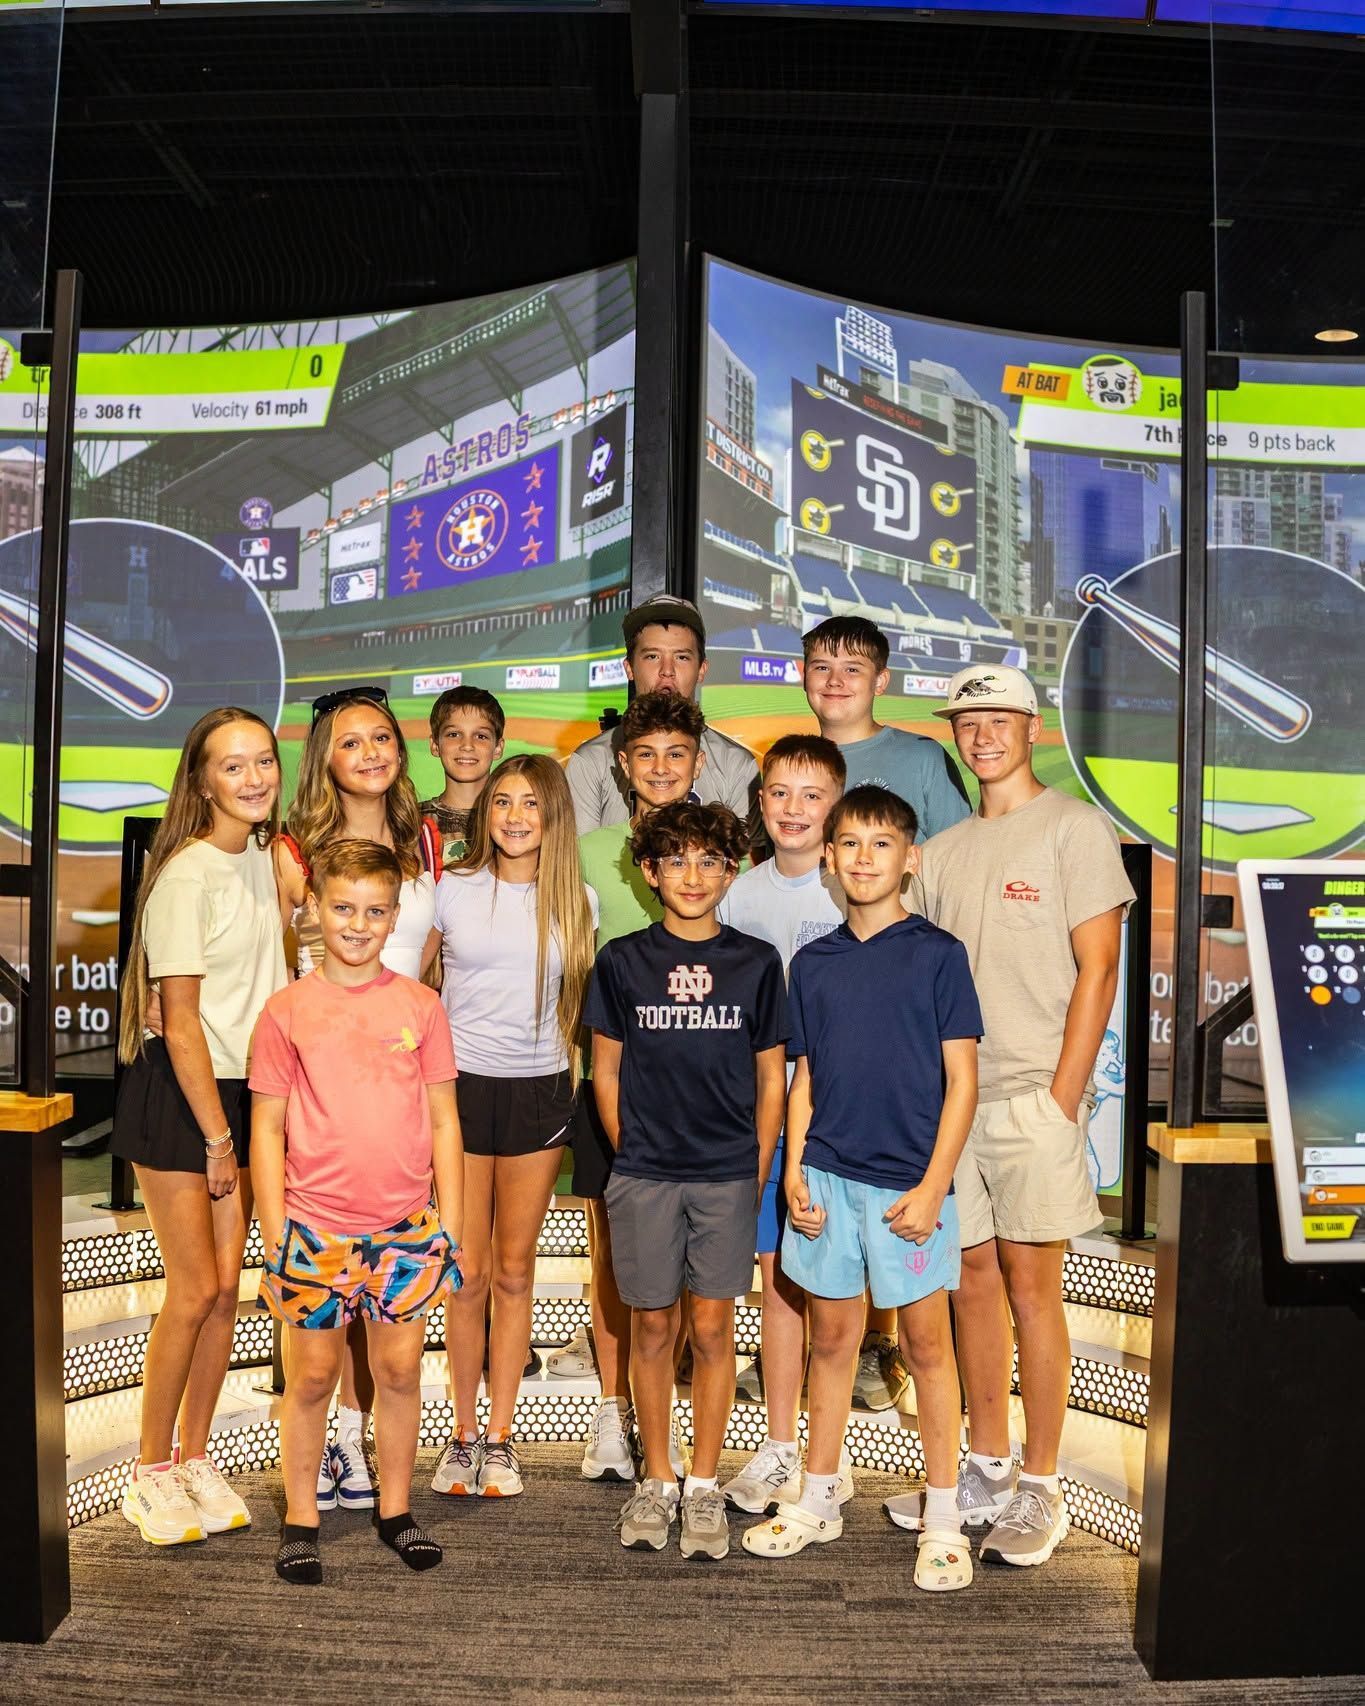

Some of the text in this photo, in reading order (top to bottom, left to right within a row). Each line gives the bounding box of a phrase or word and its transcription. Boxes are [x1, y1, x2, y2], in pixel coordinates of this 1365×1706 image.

[310, 354, 323, 378] 0
[1016, 371, 1061, 392] AT BAT
[22, 397, 308, 420] Disce 308 ft Velocity 61 mph
[420, 412, 531, 487] ASTROS
[1144, 424, 1173, 443] 7th
[1248, 431, 1259, 448] 9
[1264, 432, 1291, 452] pts
[1295, 432, 1336, 452] back
[716, 428, 757, 474] DISTRICT
[446, 493, 500, 523] HOUSTON
[446, 542, 495, 567] ASTROS
[1003, 892, 1040, 902] DRAKE
[78, 1002, 110, 1032] to
[635, 1005, 743, 1030] FOOTBALL
